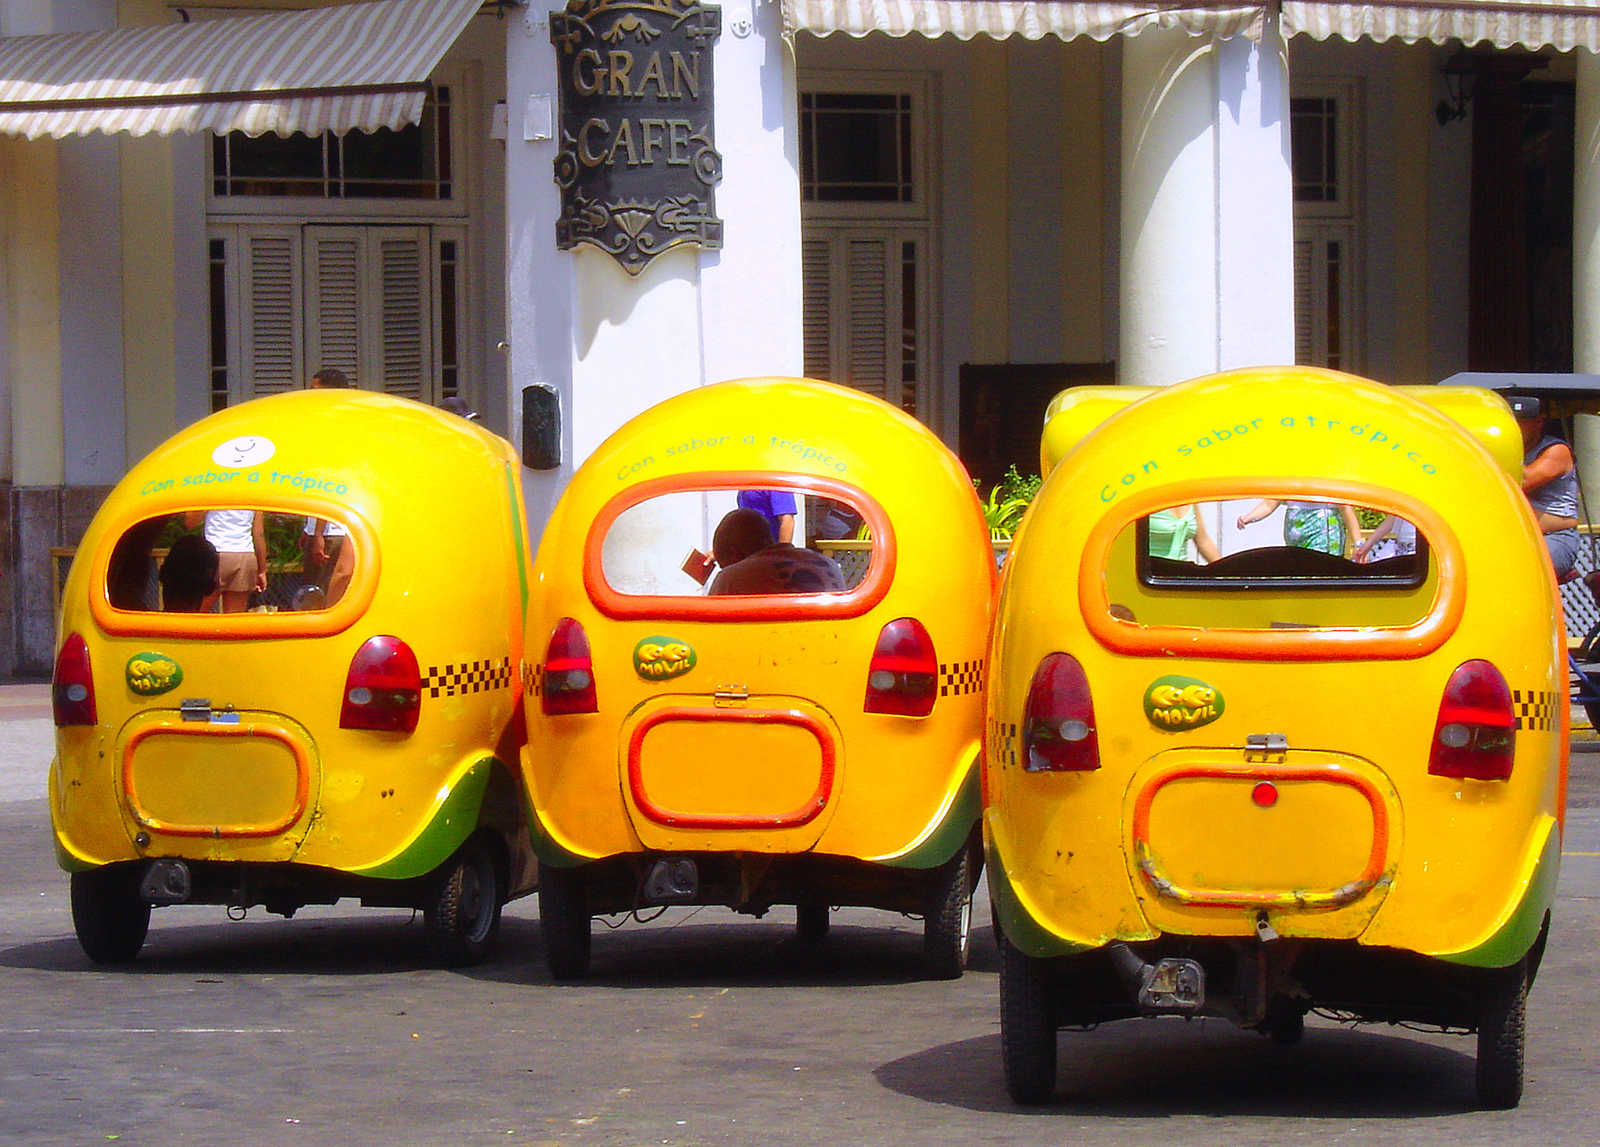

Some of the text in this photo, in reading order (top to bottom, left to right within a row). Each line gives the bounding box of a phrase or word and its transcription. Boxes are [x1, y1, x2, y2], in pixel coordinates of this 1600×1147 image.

[573, 48, 701, 99] GRAN
[577, 118, 693, 168] CAFE
[140, 469, 349, 496] Con sabor a trópico
[616, 434, 848, 482] Con sabor a trópico
[1099, 459, 1160, 504] Con
[1177, 416, 1264, 457] sabor
